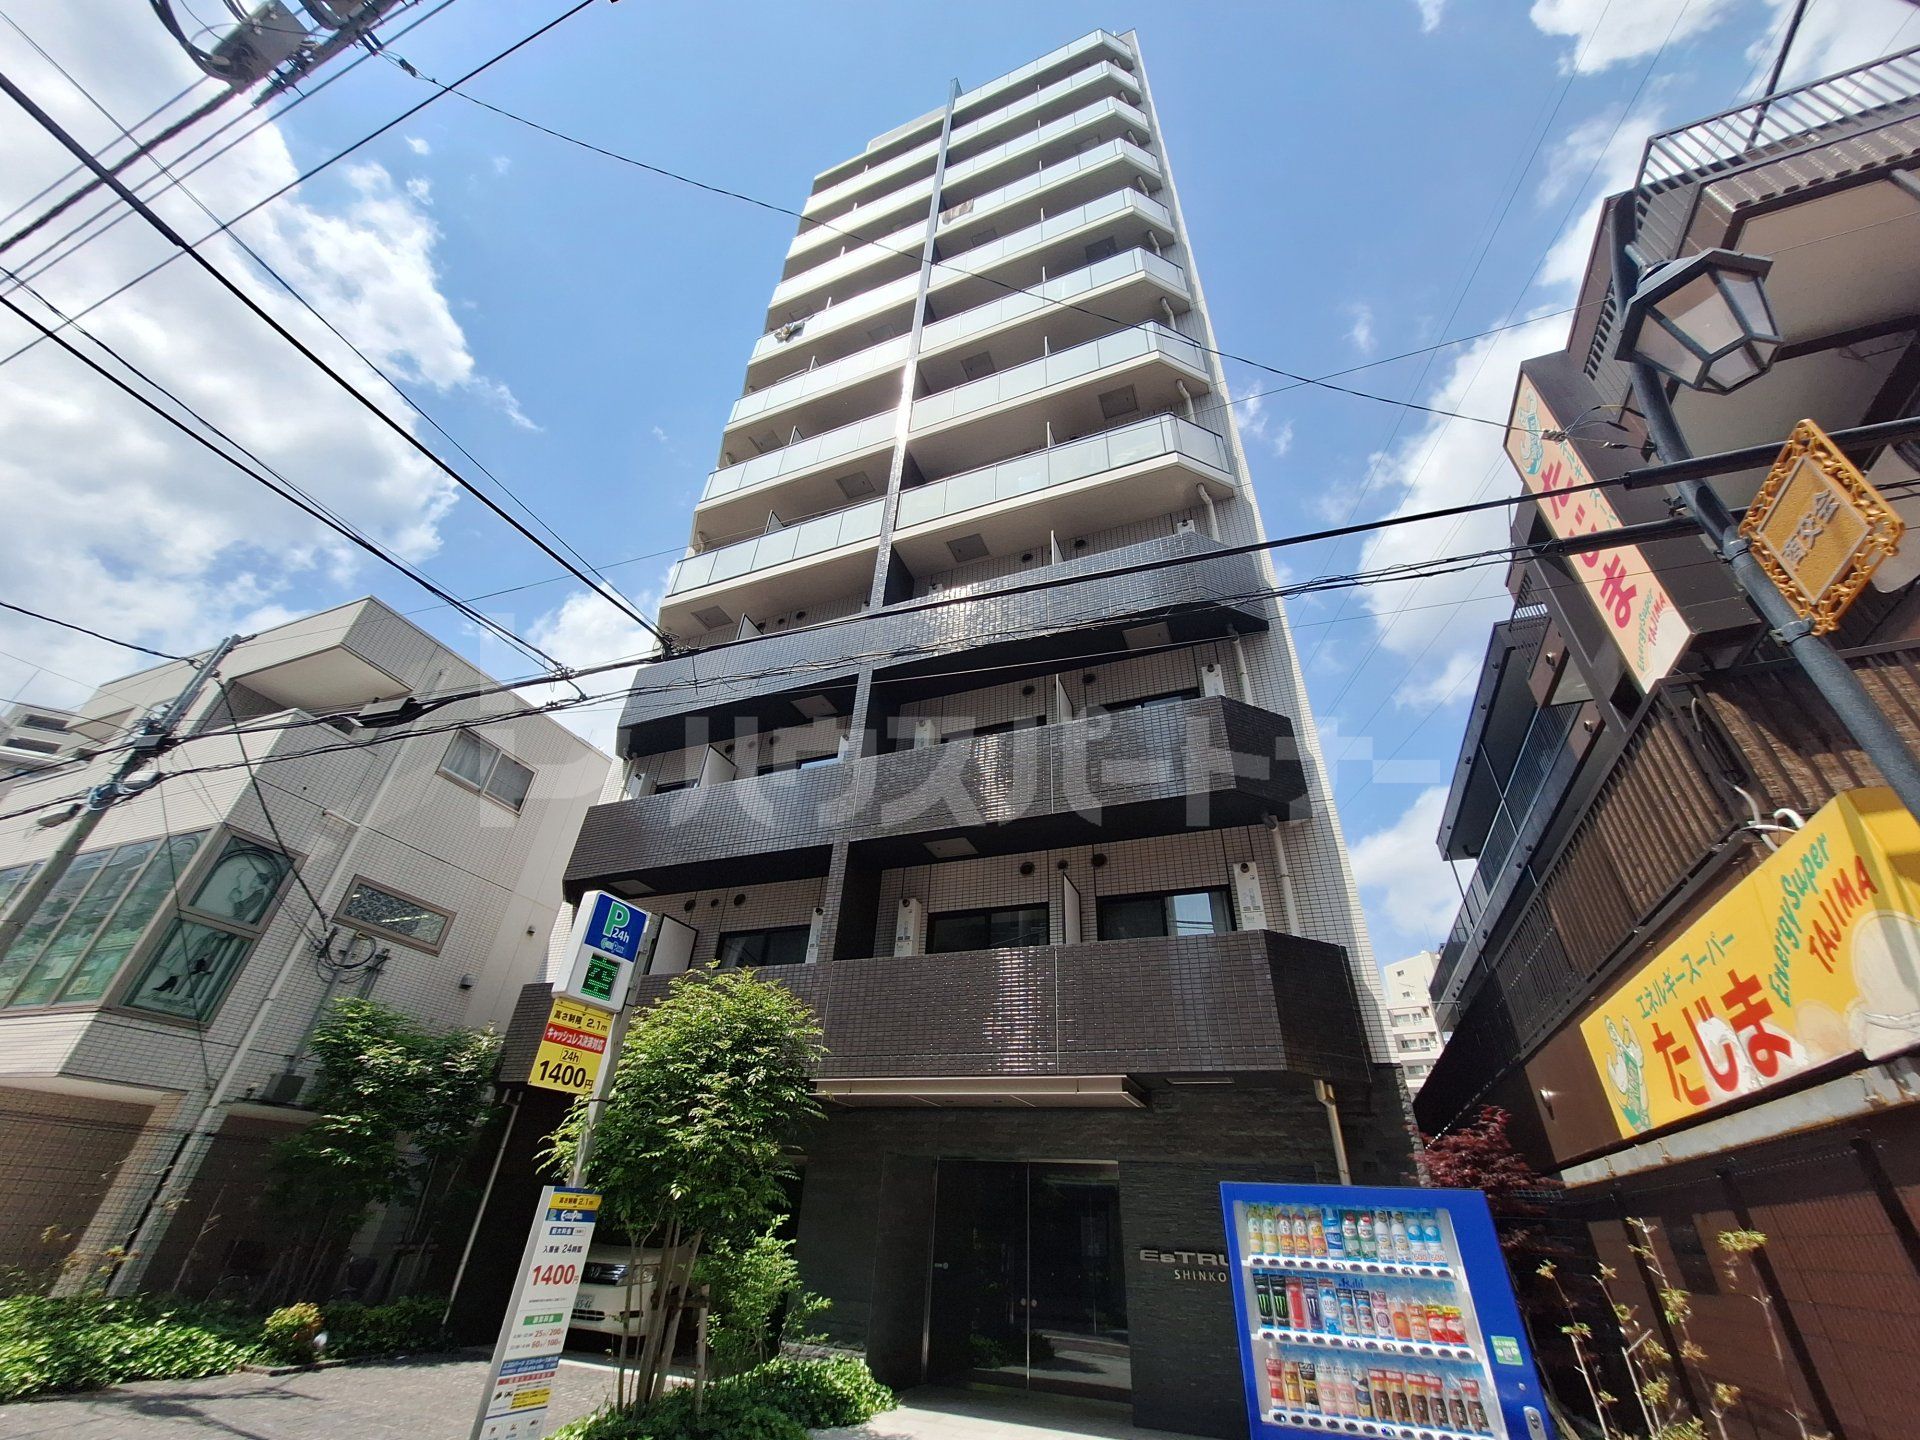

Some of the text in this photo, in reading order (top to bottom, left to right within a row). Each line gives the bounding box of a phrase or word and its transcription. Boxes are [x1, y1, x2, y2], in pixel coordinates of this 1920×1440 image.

[1647, 591, 1668, 647] TAJIMA
[602, 900, 630, 937] P
[1768, 832, 1830, 1008] Energy Super
[1809, 855, 1879, 975] TAJIMA
[612, 928, 630, 943] 24h
[1635, 930, 1735, 1020] エネルギースーパー
[554, 1010, 583, 1025] 高さ制限
[1651, 968, 1793, 1106] たじま
[562, 1049, 580, 1063] 24h
[539, 1060, 594, 1090] 1400円
[532, 1264, 580, 1286] 1400円
[1174, 1269, 1227, 1283] SHINKO
